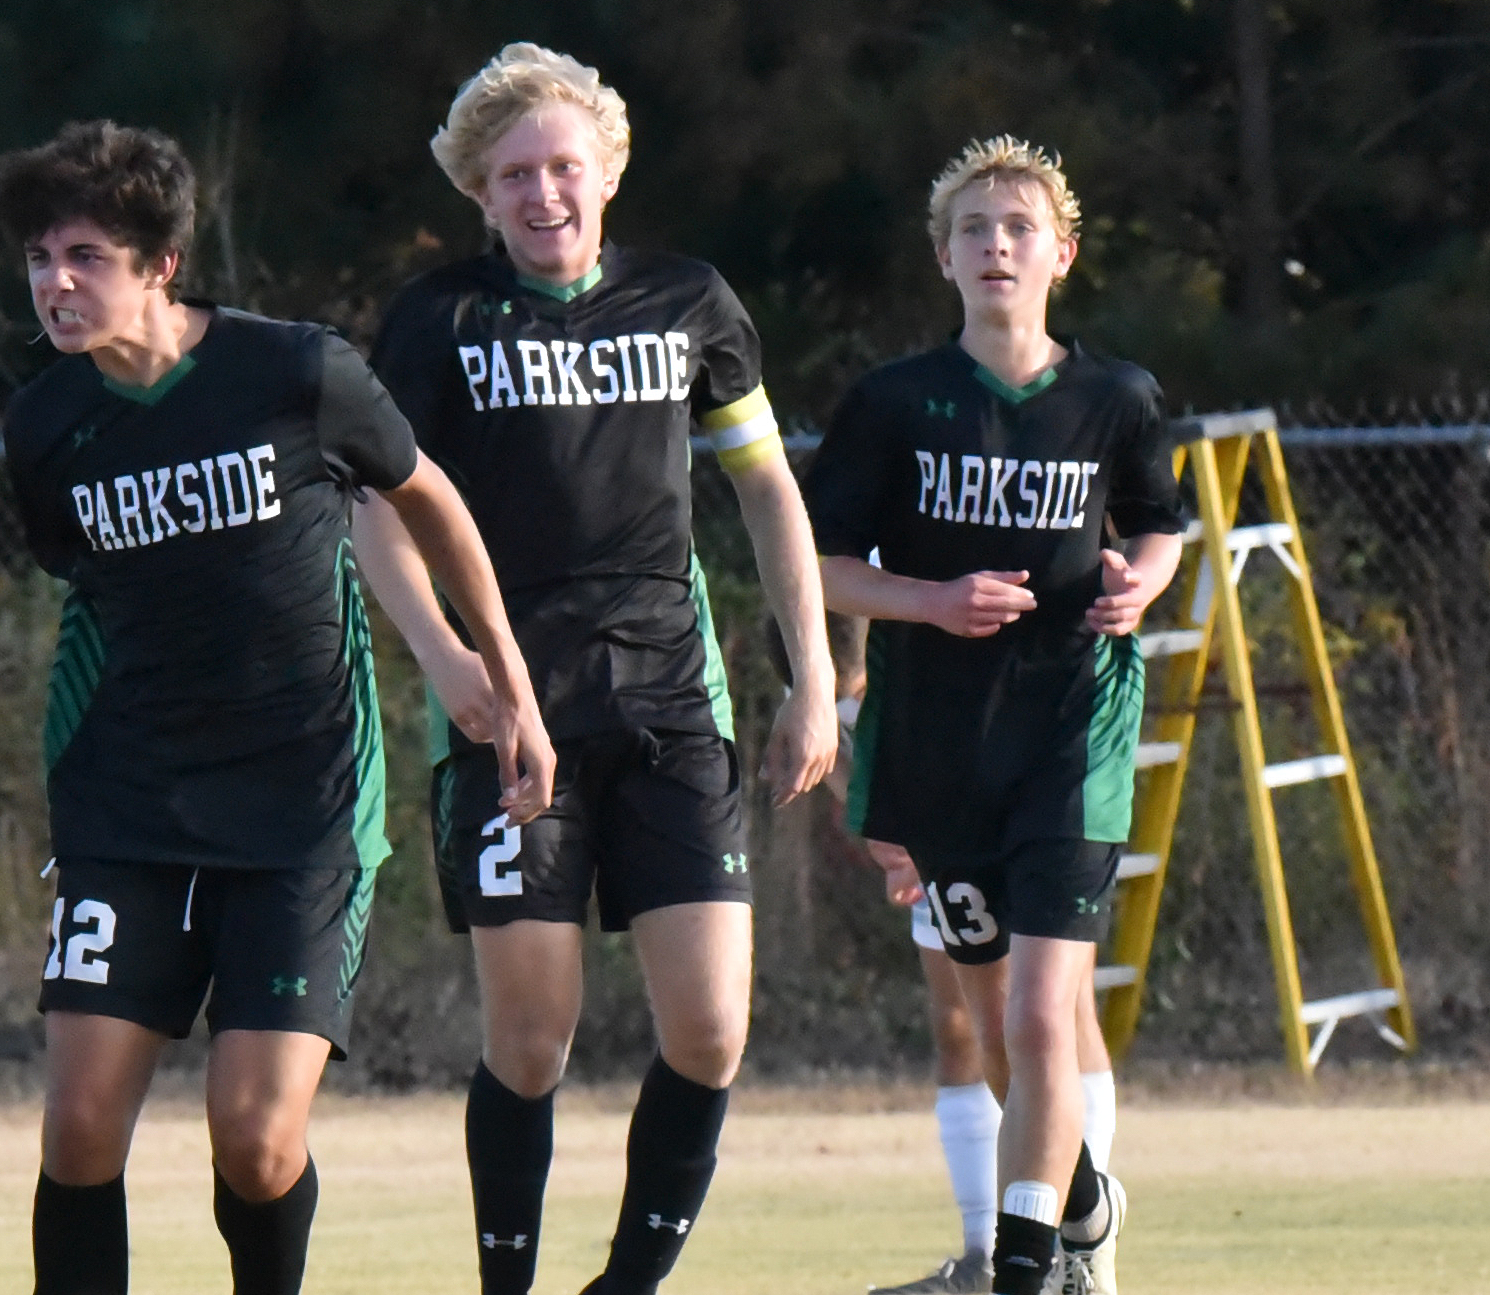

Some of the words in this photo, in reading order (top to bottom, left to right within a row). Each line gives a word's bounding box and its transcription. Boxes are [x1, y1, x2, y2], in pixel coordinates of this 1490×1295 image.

[459, 331, 691, 412] PARKSIDE
[72, 443, 281, 551] PARKSIDE
[478, 811, 524, 897] 2
[43, 896, 117, 985] 12
[927, 881, 999, 946] 13
